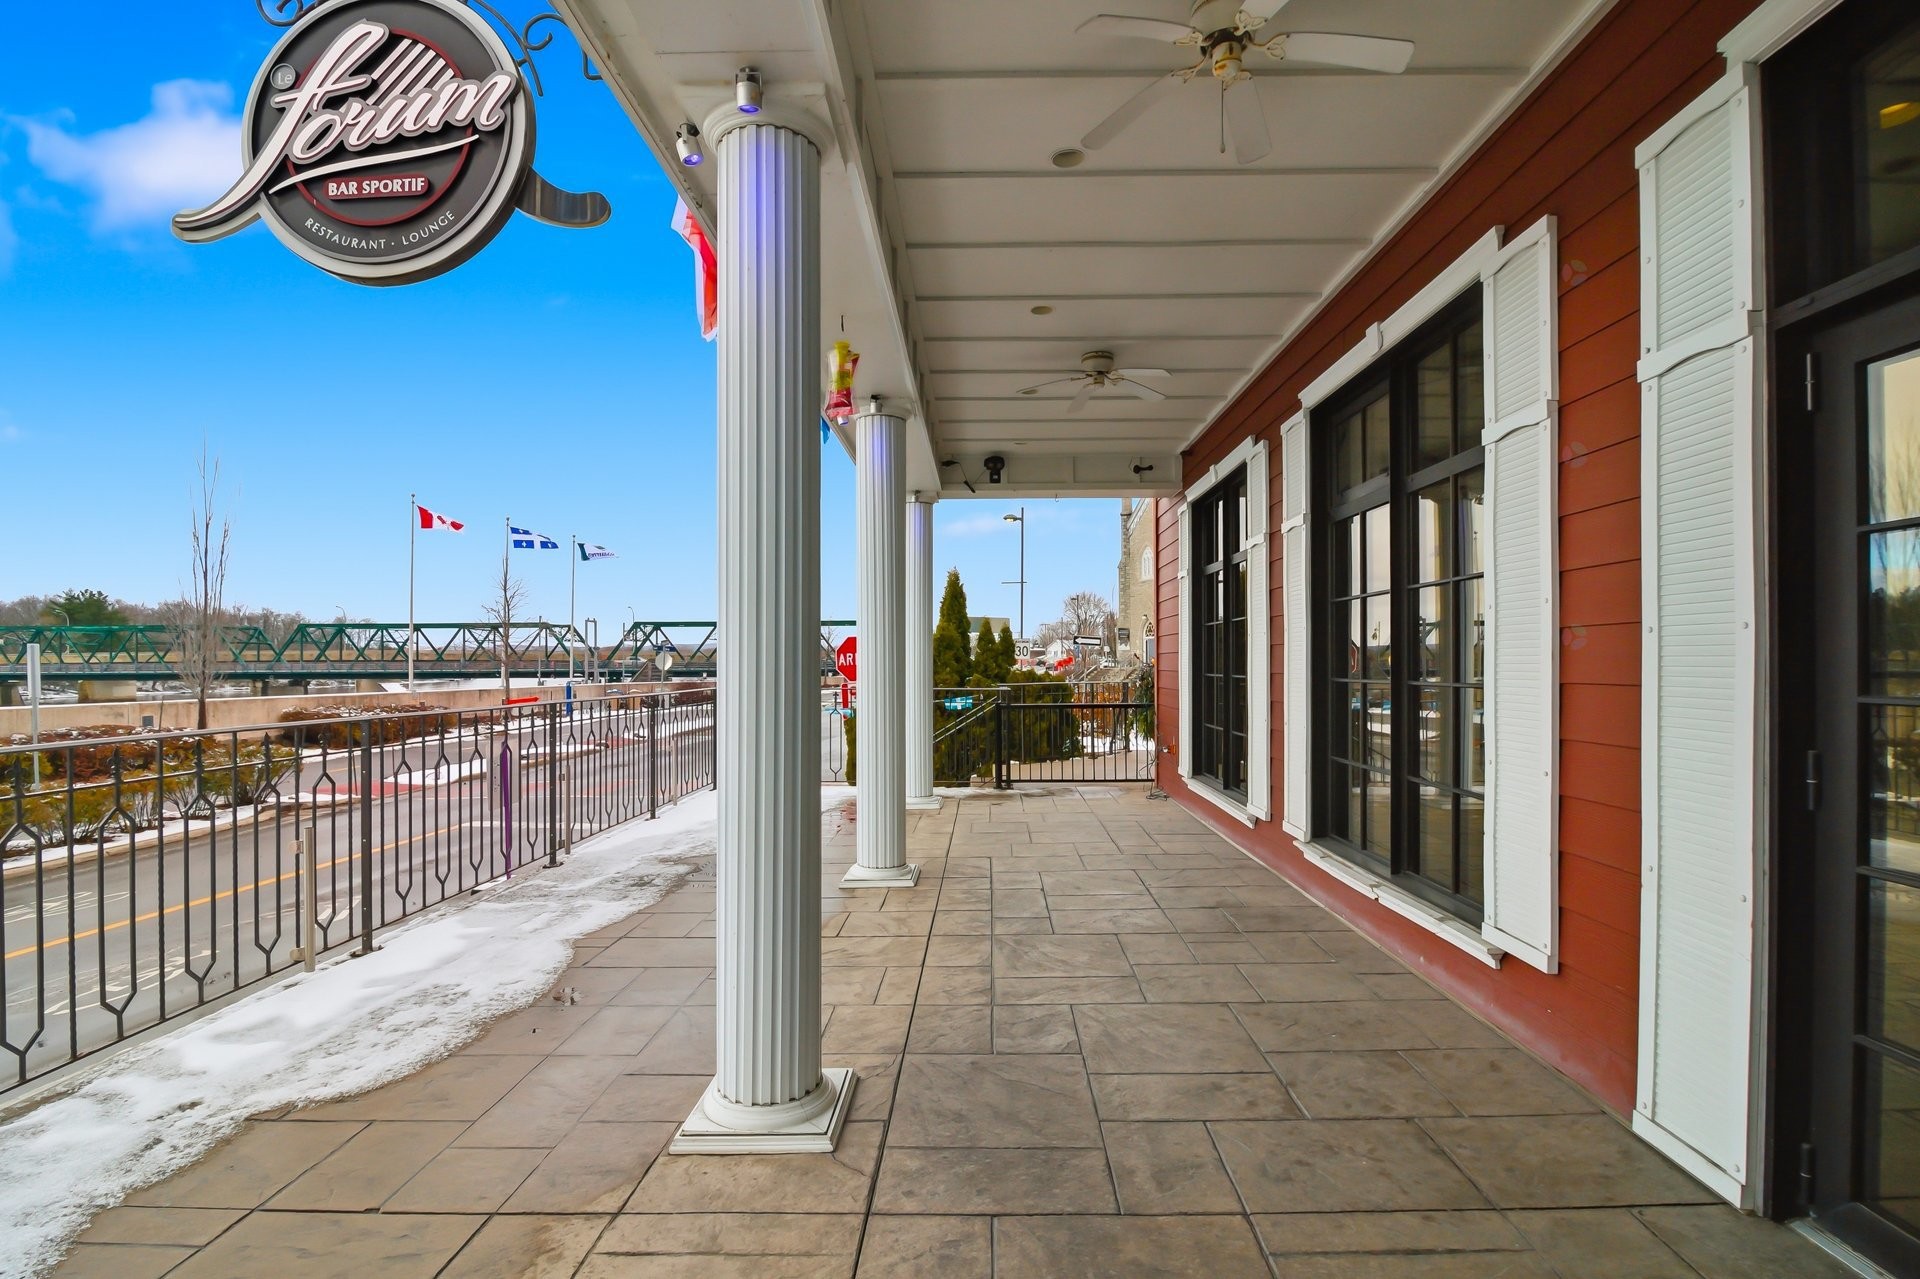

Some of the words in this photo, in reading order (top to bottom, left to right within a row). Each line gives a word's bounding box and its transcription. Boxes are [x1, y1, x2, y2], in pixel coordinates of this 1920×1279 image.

[278, 72, 293, 85] Le
[328, 181, 358, 196] BAR
[362, 177, 425, 194] SPORTIF
[304, 217, 386, 250] RESTAURANT
[401, 210, 455, 246] LOUNGE
[1015, 645, 1029, 657] 30
[838, 653, 857, 666] AR
